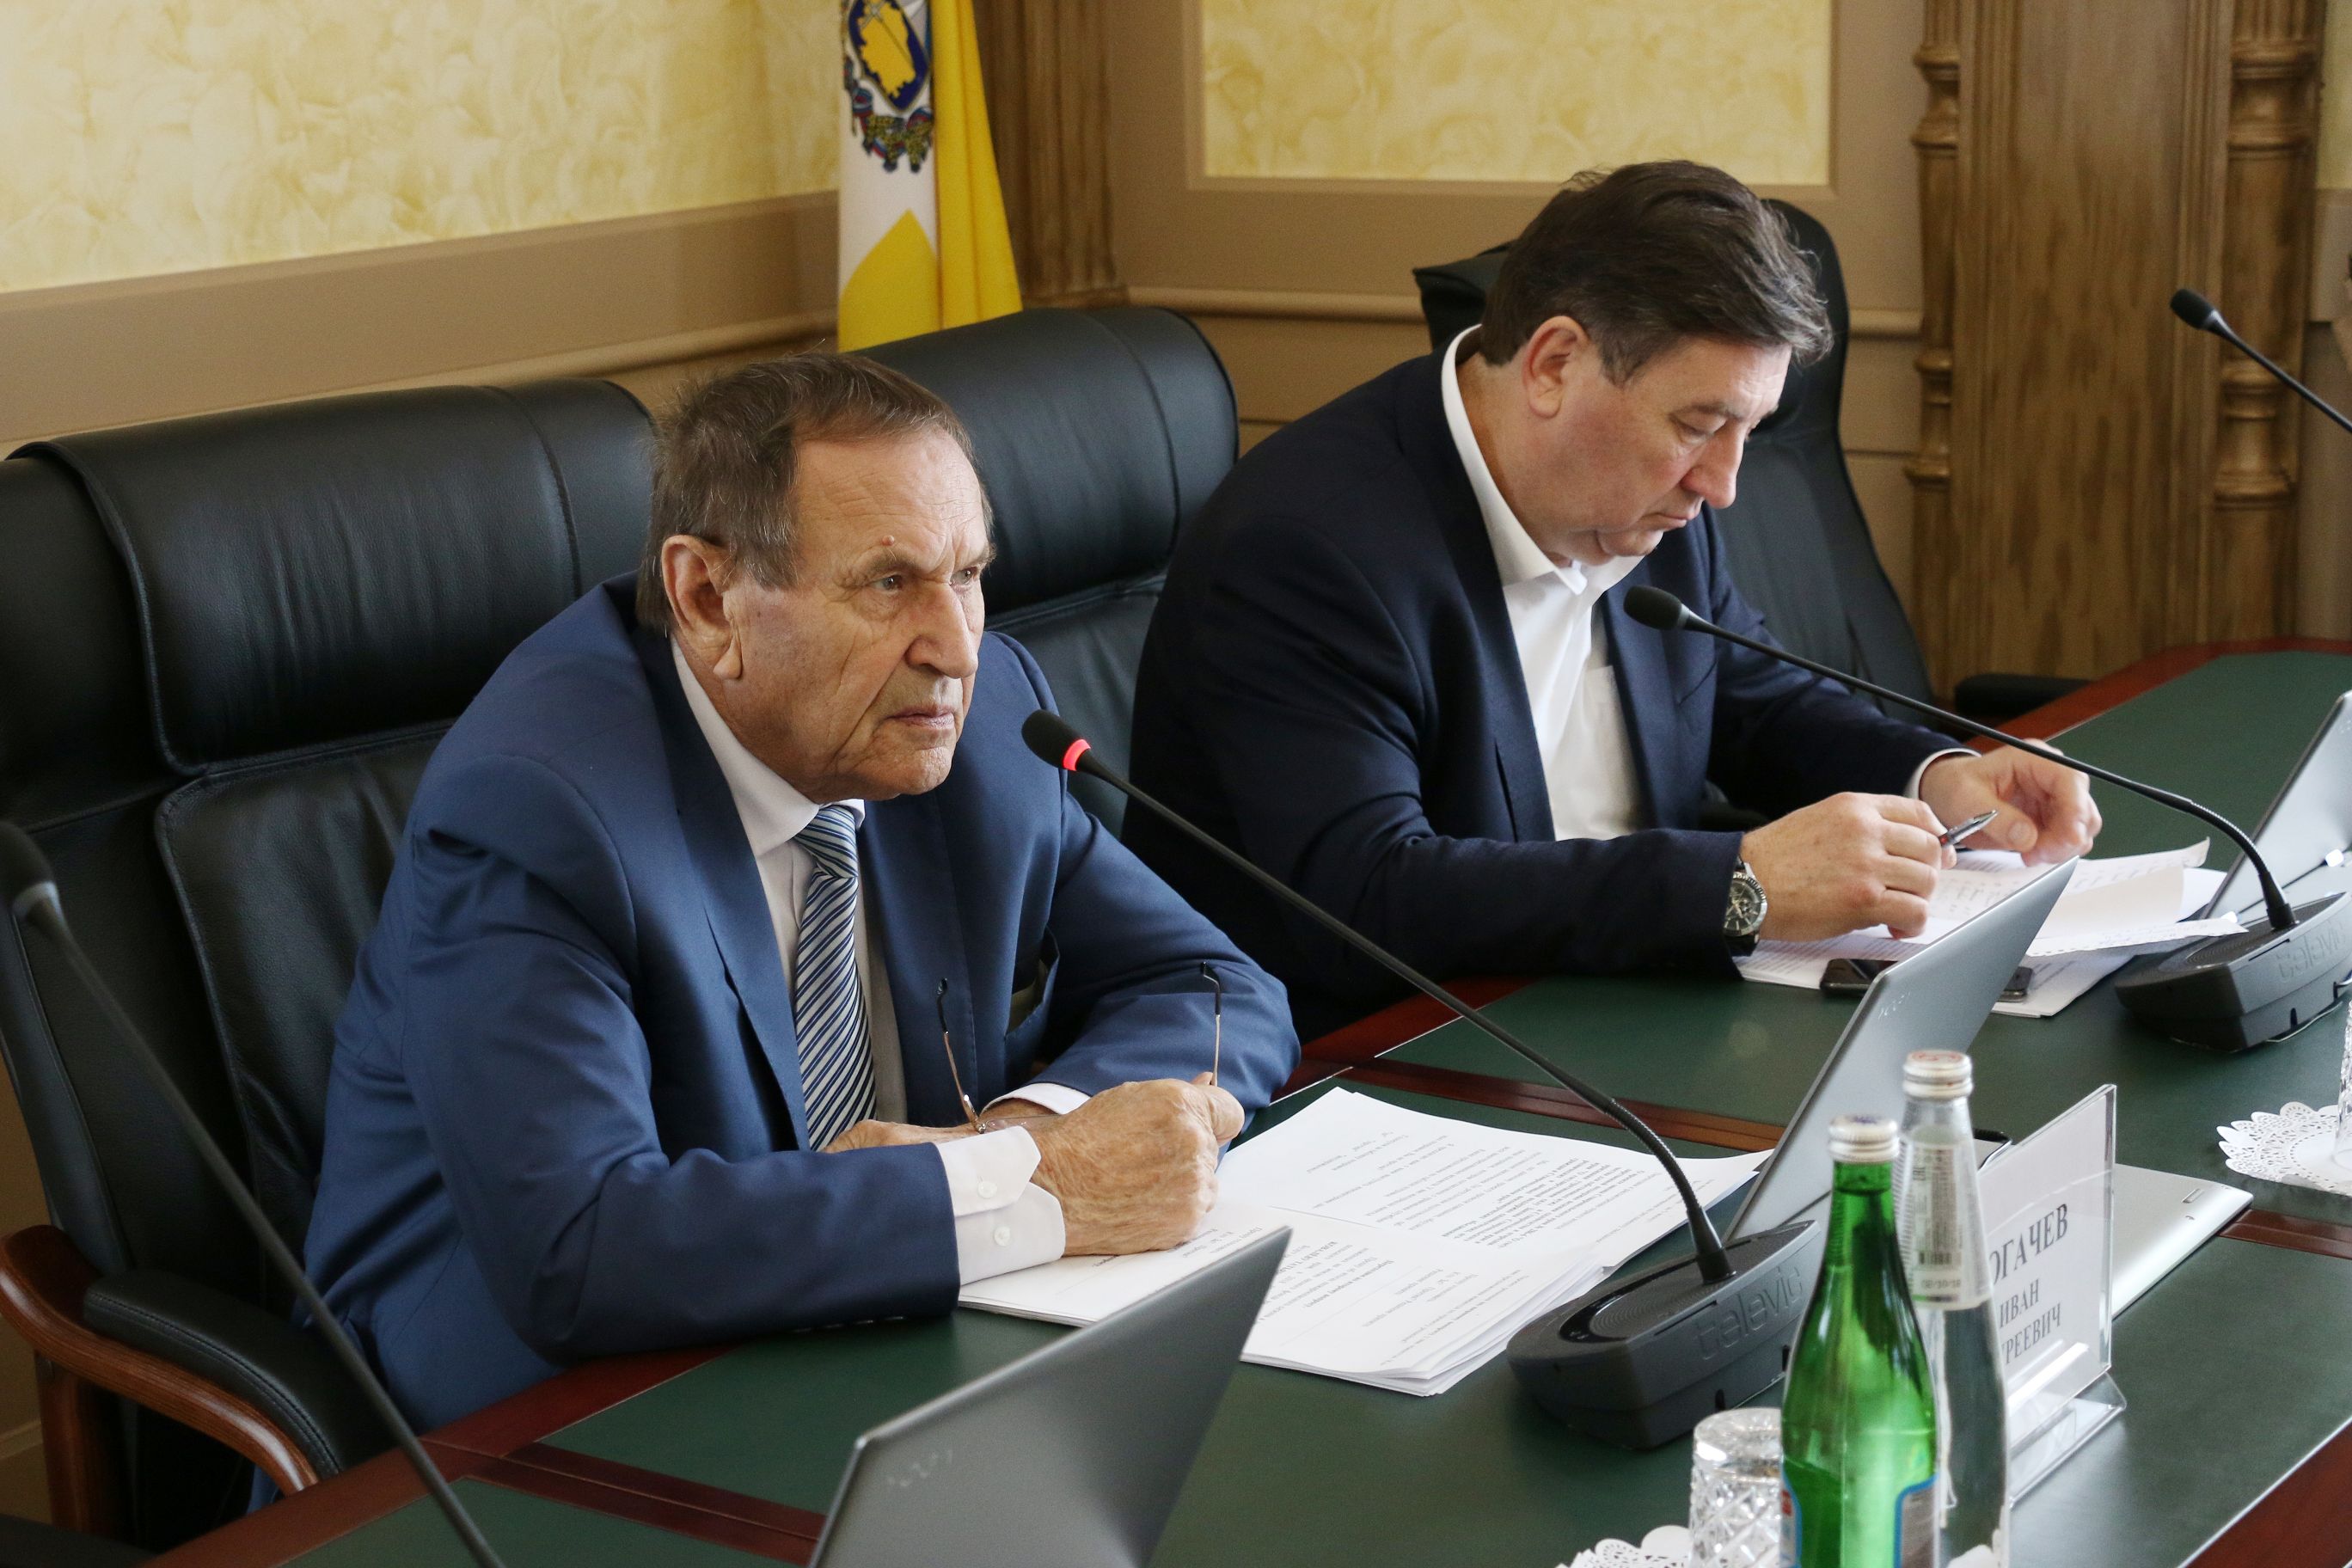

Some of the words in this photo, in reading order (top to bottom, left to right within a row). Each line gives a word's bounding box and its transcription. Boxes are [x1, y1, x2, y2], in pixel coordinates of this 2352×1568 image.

[1989, 1204, 2068, 1285] ОГАЧЕВ
[1999, 1278, 2040, 1328] ИВАН
[2001, 1302, 2061, 1365] РЕЕВИЧ
